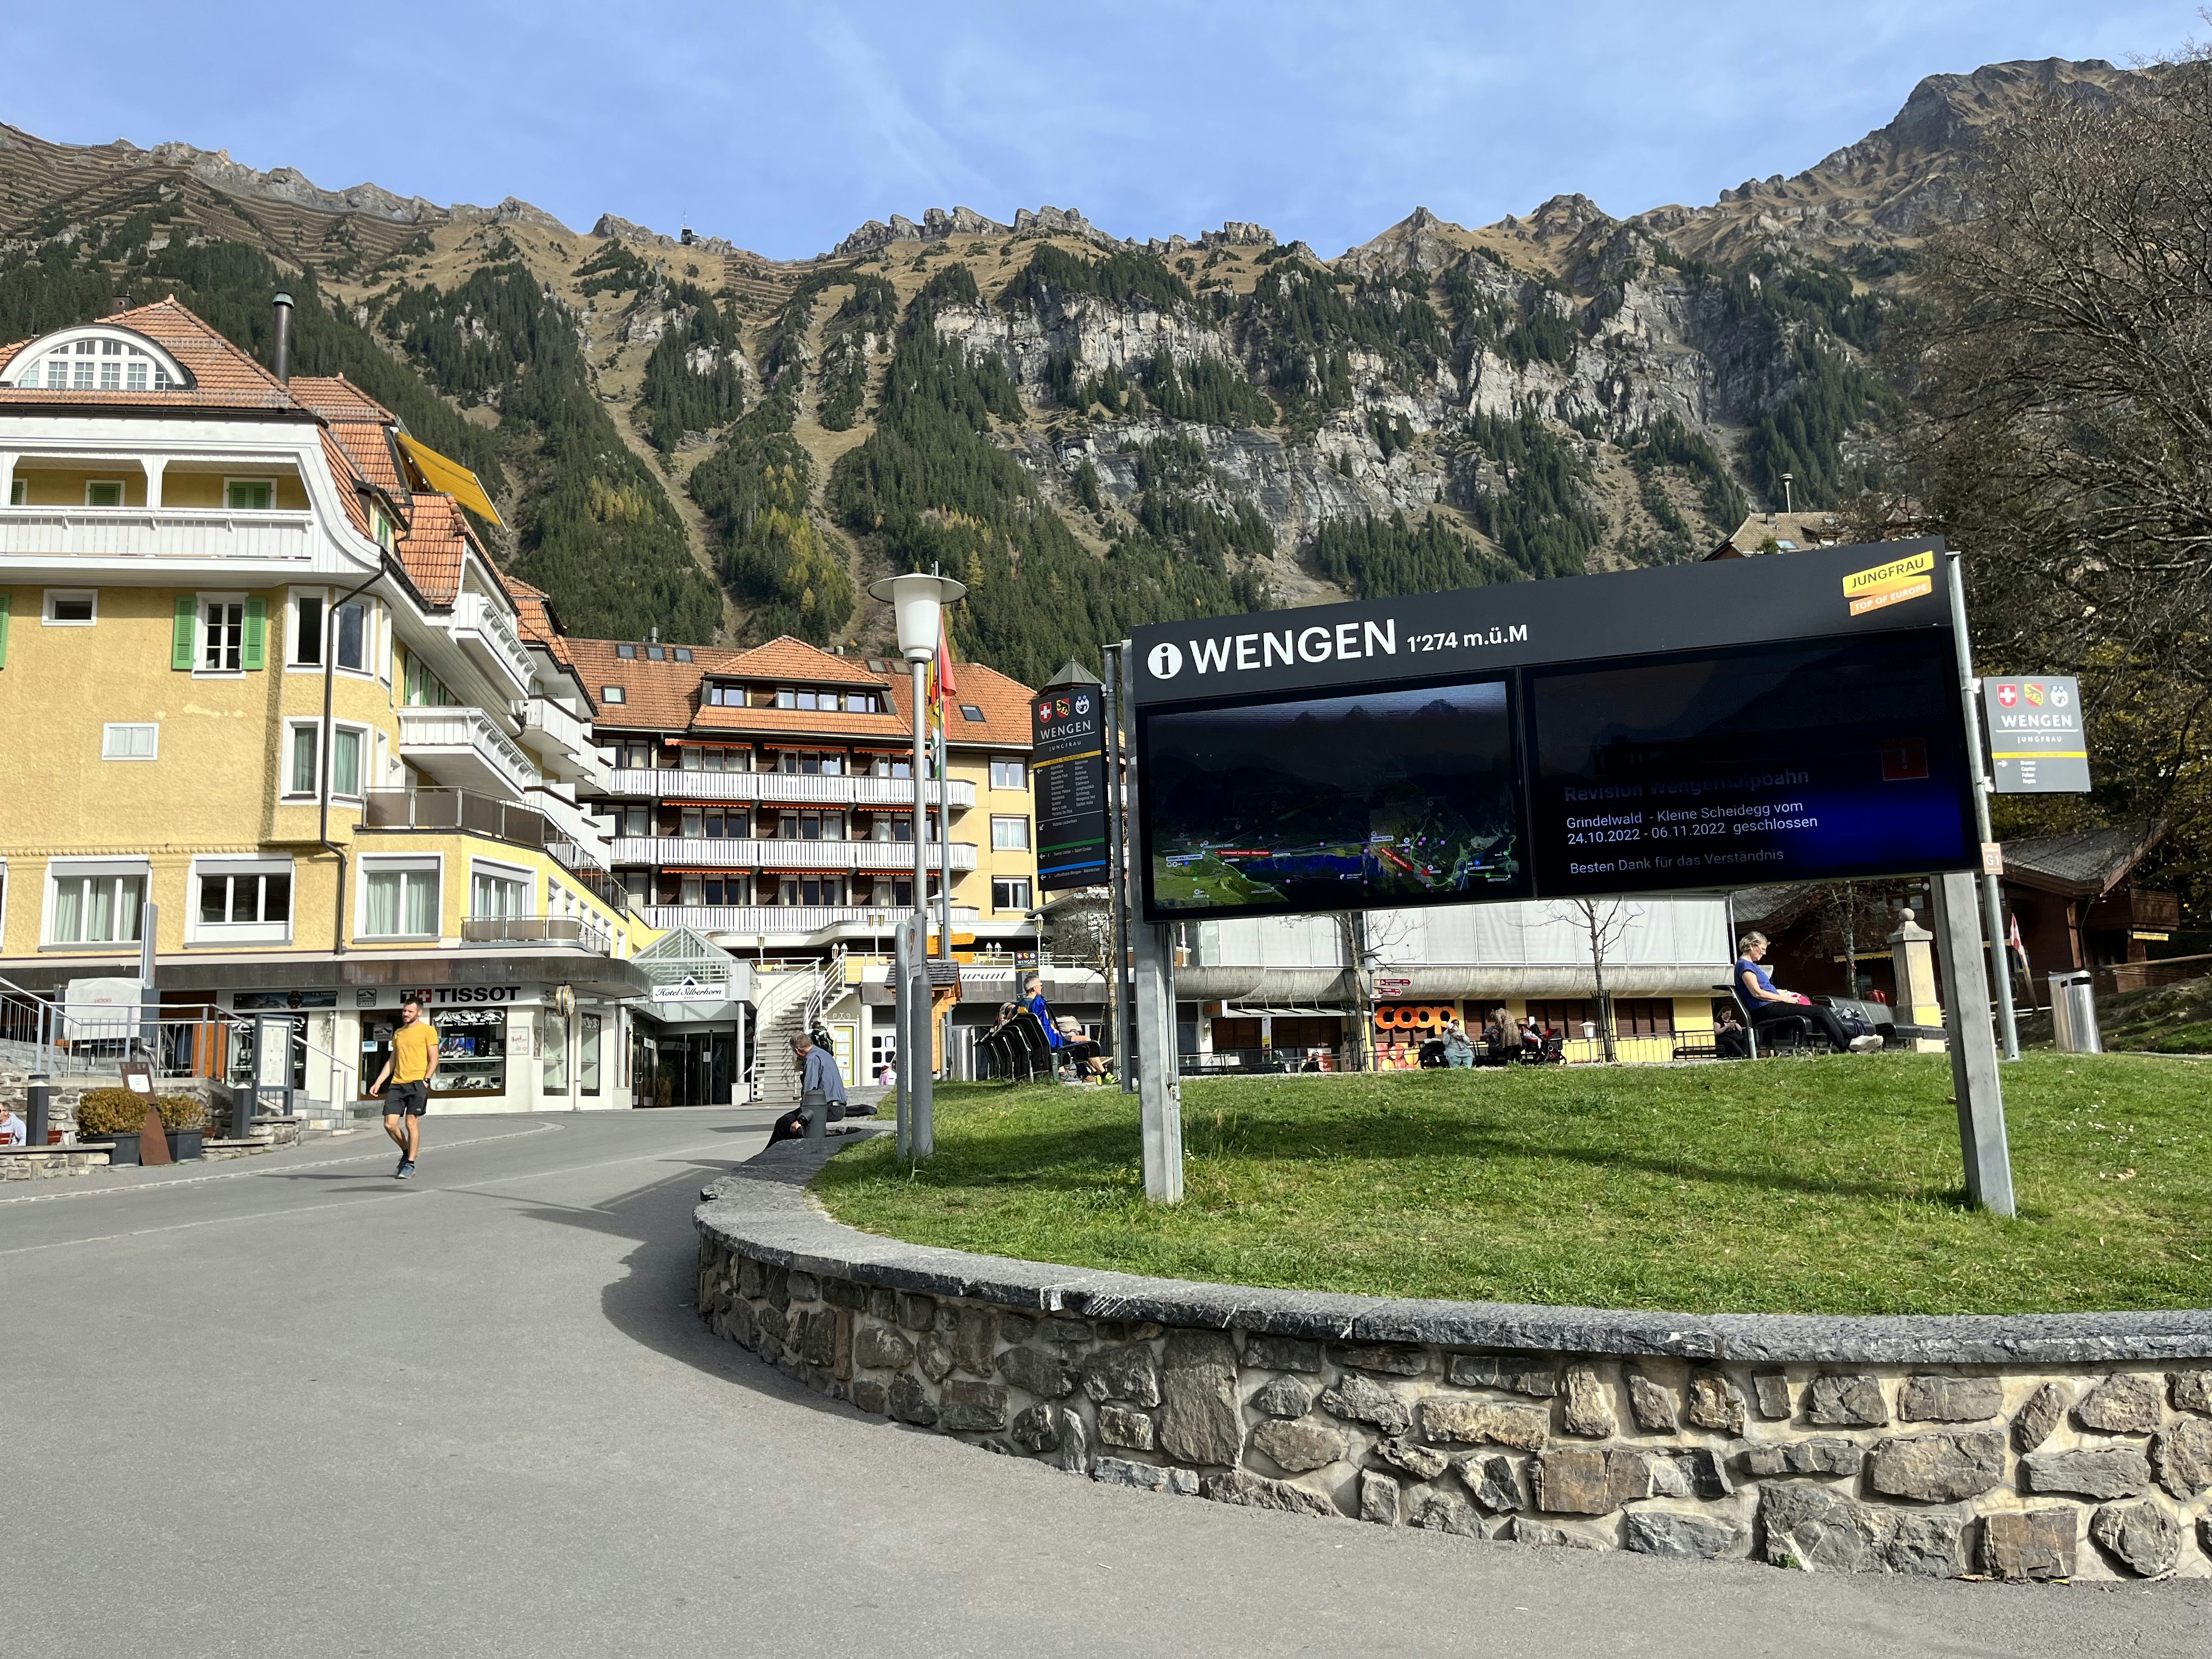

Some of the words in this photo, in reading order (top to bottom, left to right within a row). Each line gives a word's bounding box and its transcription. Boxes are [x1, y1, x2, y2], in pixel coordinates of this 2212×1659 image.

[1852, 557, 1924, 588] JUNGFRAU
[1854, 600, 1873, 611] TOP
[1875, 595, 1888, 605] OF
[1890, 583, 1927, 601] EUROPE
[1189, 618, 1396, 674] WENGEN
[2001, 714, 2072, 727] WENGEN
[1040, 720, 1091, 740] WENGEN
[1049, 740, 1081, 752] JUNGFRAU
[2017, 736, 2062, 744] JUNGFRAU
[1565, 785, 1643, 802] Revision
[1566, 812, 1642, 830] Grindelwald
[1657, 810, 1697, 822] Kleine
[1701, 804, 1770, 820] Scheidegg
[1774, 802, 1803, 812] vom
[1567, 828, 1641, 845] 24.10.2022
[1652, 822, 1725, 839] 06.11.2022
[1734, 816, 1818, 835] geschlossen
[1570, 861, 1615, 874] Besten
[1619, 858, 1652, 871] Dank
[1655, 856, 1673, 869] für
[1677, 854, 1701, 867] das
[1704, 849, 1784, 866] Verständnis
[1985, 854, 2000, 866] G1
[960, 972, 1007, 980] urant
[435, 986, 521, 1003] TISSOT
[656, 988, 681, 996] Hotel
[681, 987, 722, 996] Silberhorn
[1375, 1006, 1458, 1035] coop
